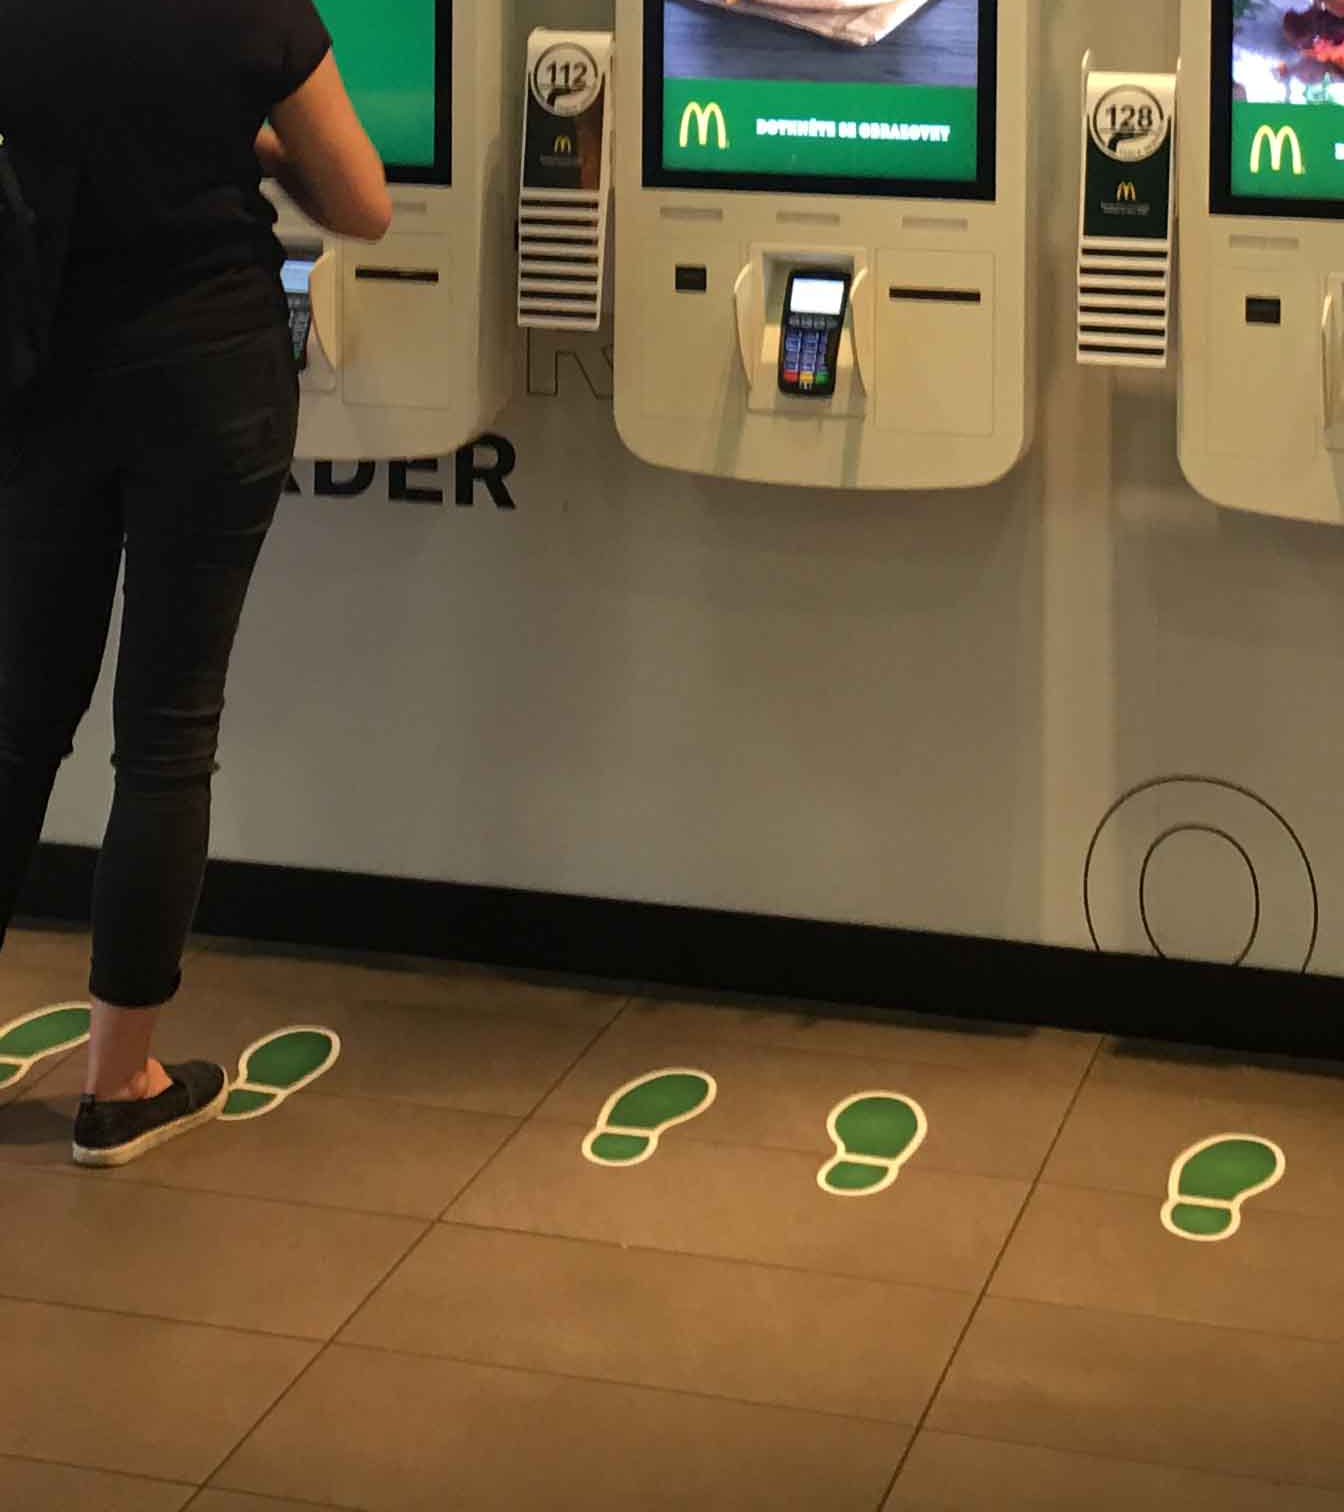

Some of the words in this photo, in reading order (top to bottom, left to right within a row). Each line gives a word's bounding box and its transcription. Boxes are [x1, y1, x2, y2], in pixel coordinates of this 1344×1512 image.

[546, 61, 587, 87] 112
[1105, 104, 1153, 129] 128
[284, 434, 516, 510] DER
